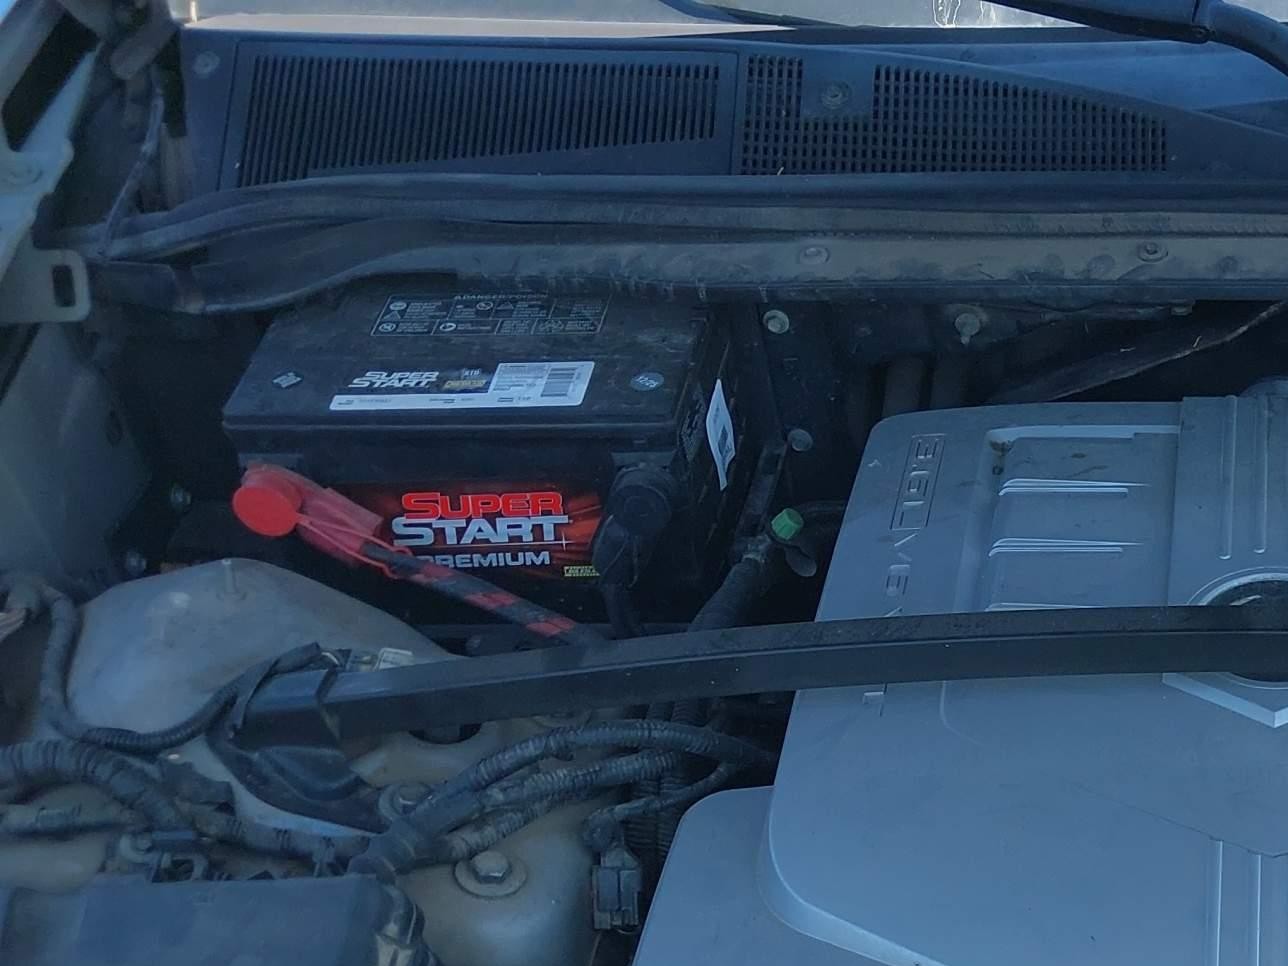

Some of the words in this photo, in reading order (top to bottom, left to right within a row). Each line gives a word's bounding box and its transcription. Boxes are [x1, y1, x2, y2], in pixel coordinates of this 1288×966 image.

[348, 378, 437, 388] START
[364, 371, 440, 380] SUPER
[402, 491, 564, 520] SUPER
[391, 515, 569, 546] START
